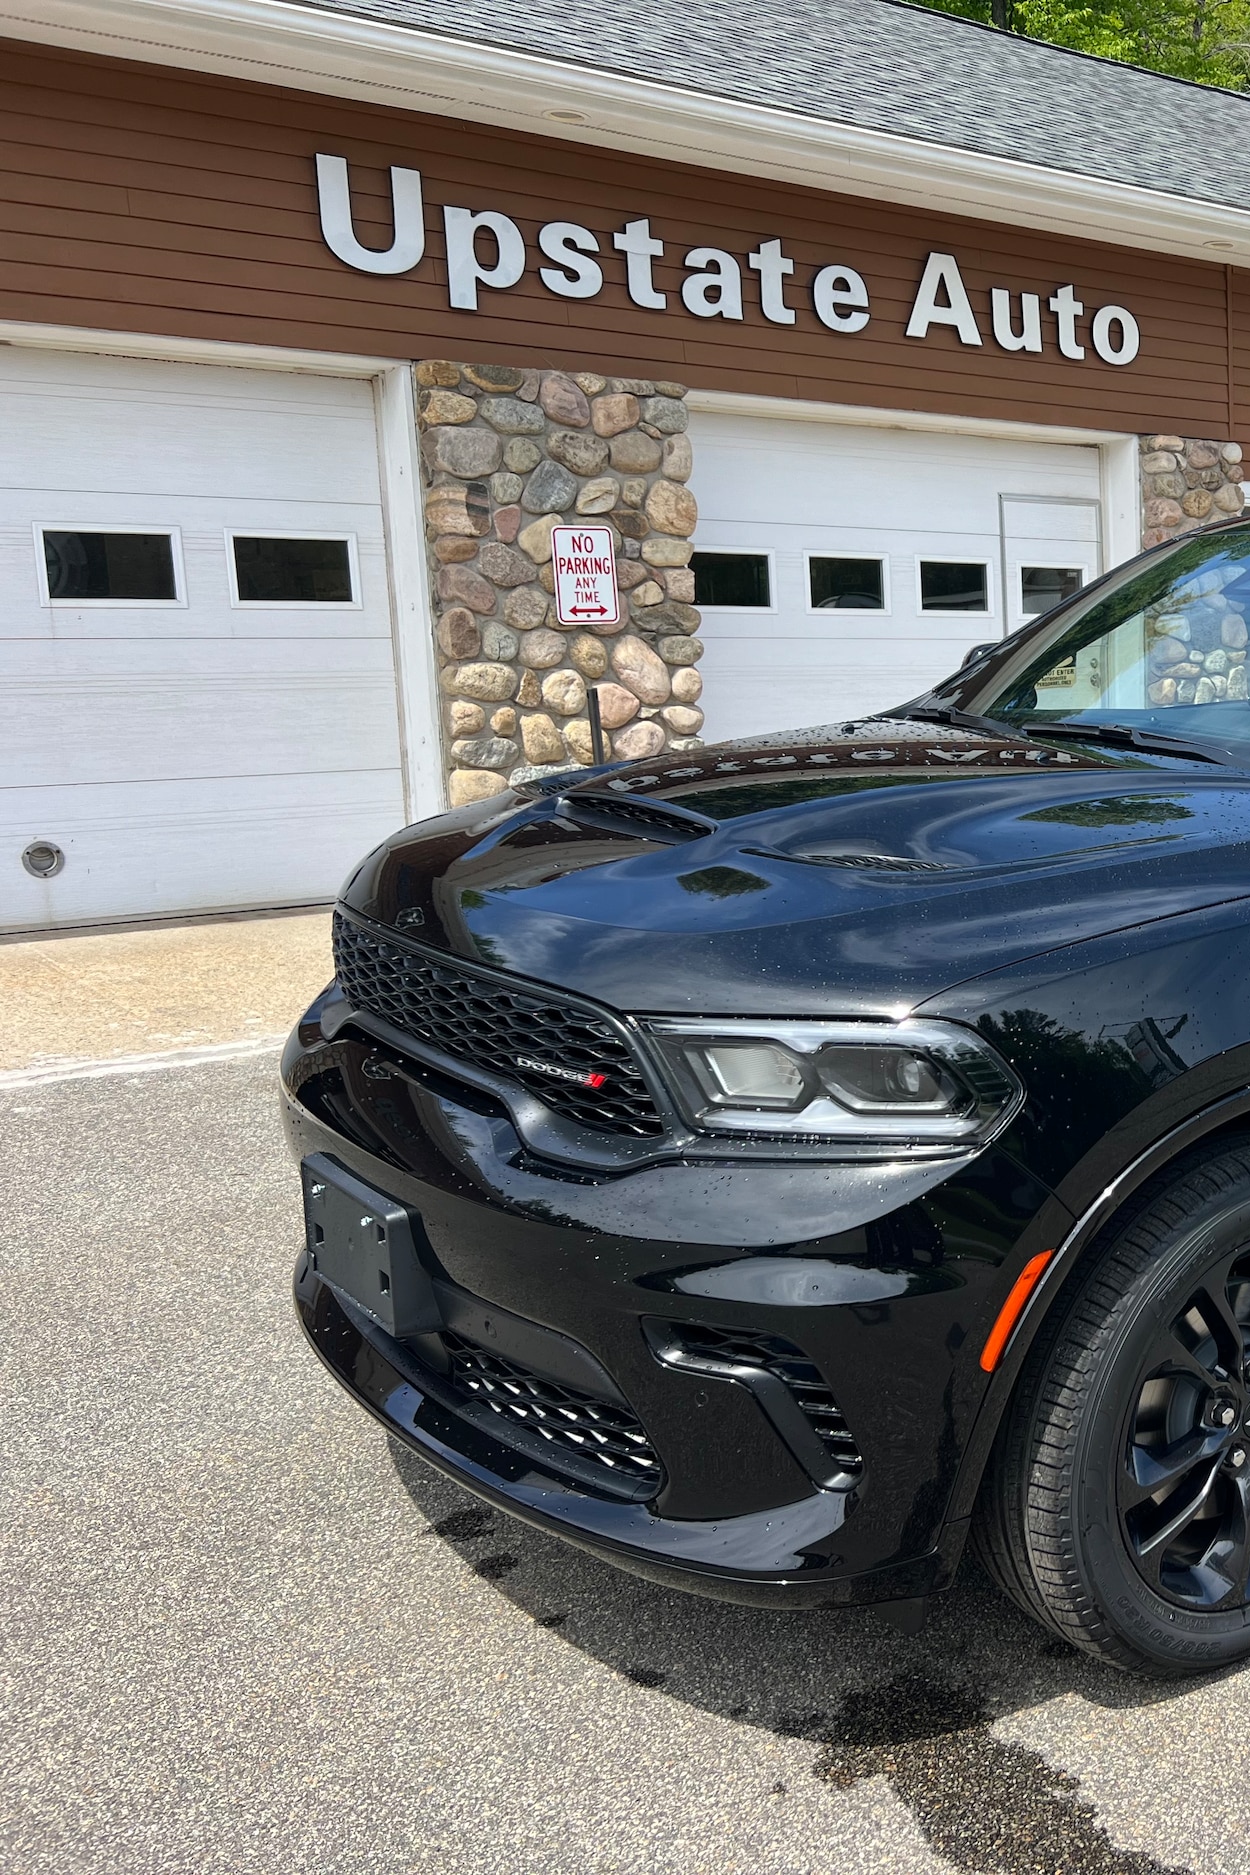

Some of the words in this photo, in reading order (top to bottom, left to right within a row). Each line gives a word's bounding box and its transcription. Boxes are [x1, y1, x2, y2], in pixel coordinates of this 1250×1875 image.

[314, 152, 871, 334] Upstate
[904, 251, 1141, 366] Auto
[571, 535, 594, 554] NO
[559, 557, 611, 575] PARKING
[575, 577, 597, 589] ANY
[574, 591, 600, 603] TIME
[518, 1057, 592, 1083] DODGE
